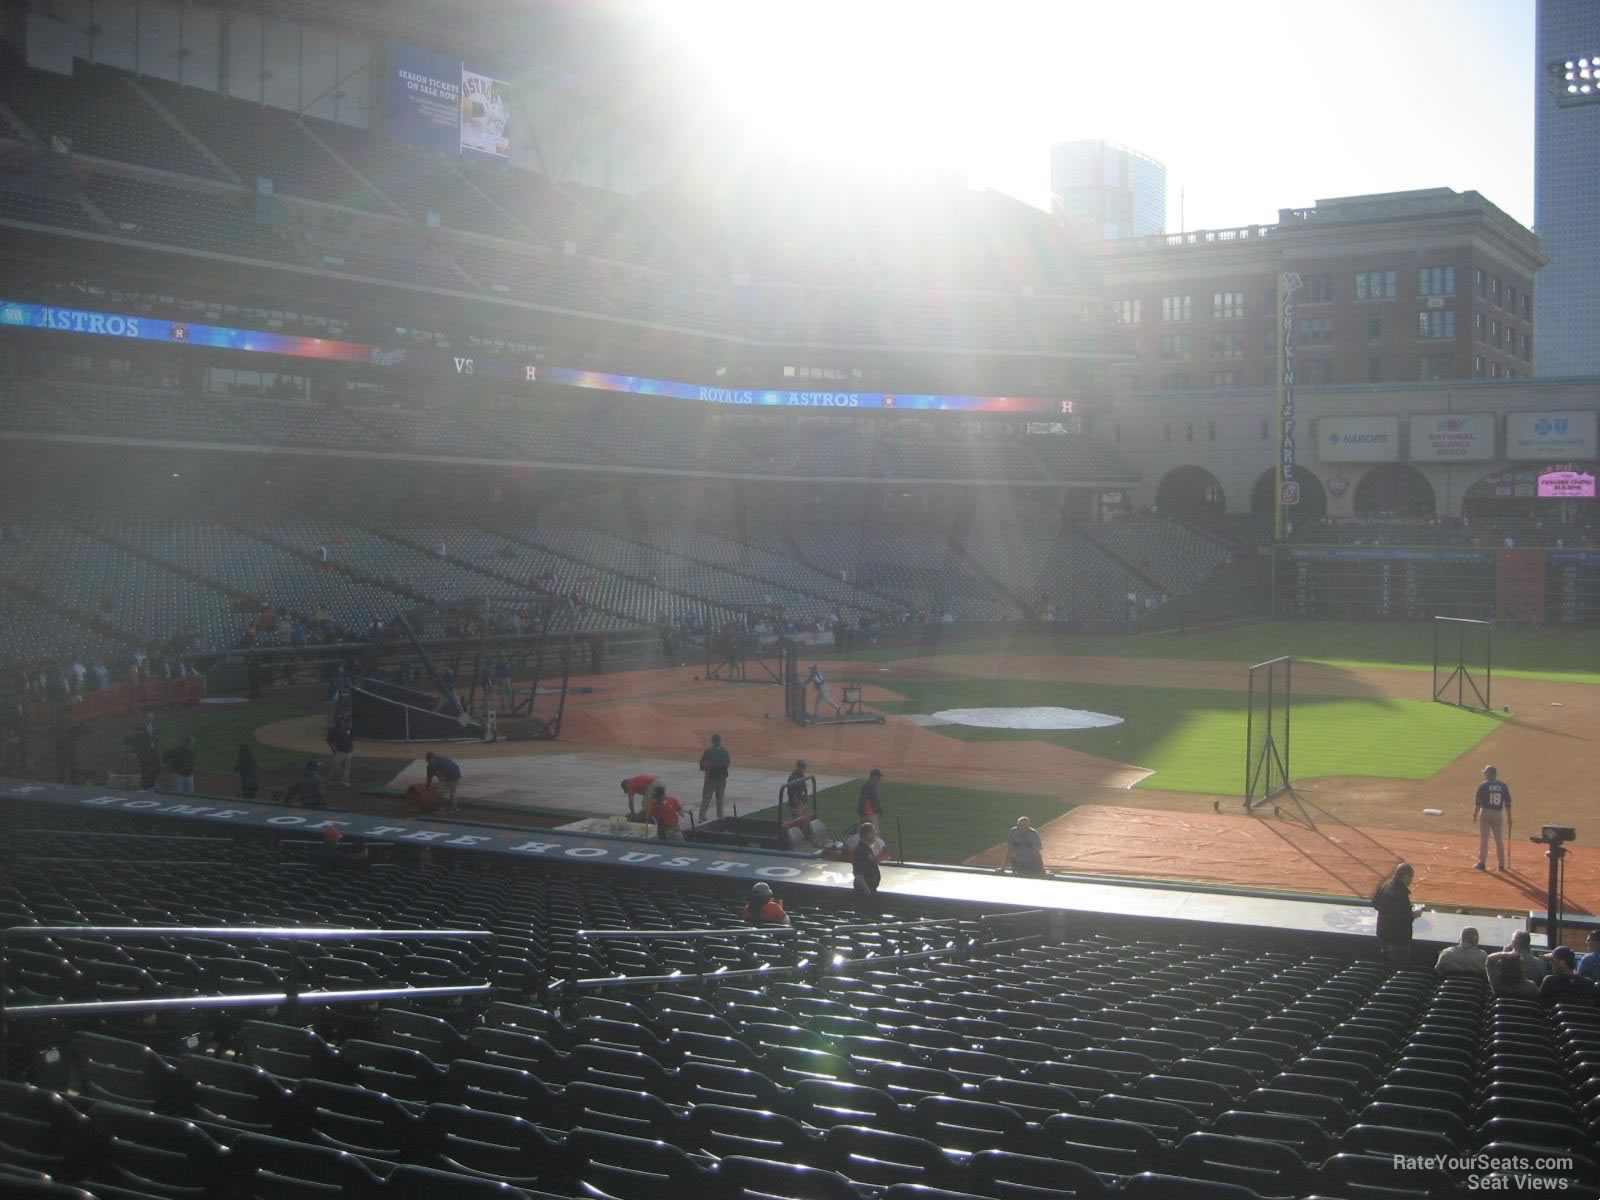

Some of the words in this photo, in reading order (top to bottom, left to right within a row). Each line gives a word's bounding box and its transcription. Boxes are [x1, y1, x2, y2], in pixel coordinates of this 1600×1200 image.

[399, 70, 427, 86] SEASON
[428, 78, 460, 94] TICKETS
[407, 81, 418, 91] ON
[420, 84, 438, 97] SALE
[440, 90, 459, 103] NOW!
[37, 308, 139, 338] ASTROS
[453, 357, 475, 376] VS
[699, 386, 753, 405] ROYALS
[787, 391, 860, 408] ASTROS
[1061, 399, 1073, 413] H
[1342, 434, 1390, 444] NABORS
[1428, 433, 1476, 441] NATIONAL
[1436, 448, 1468, 456] VARCO
[1489, 792, 1502, 806] 18
[80, 794, 251, 819] HOME
[266, 815, 352, 829] OF
[364, 825, 492, 847] THE
